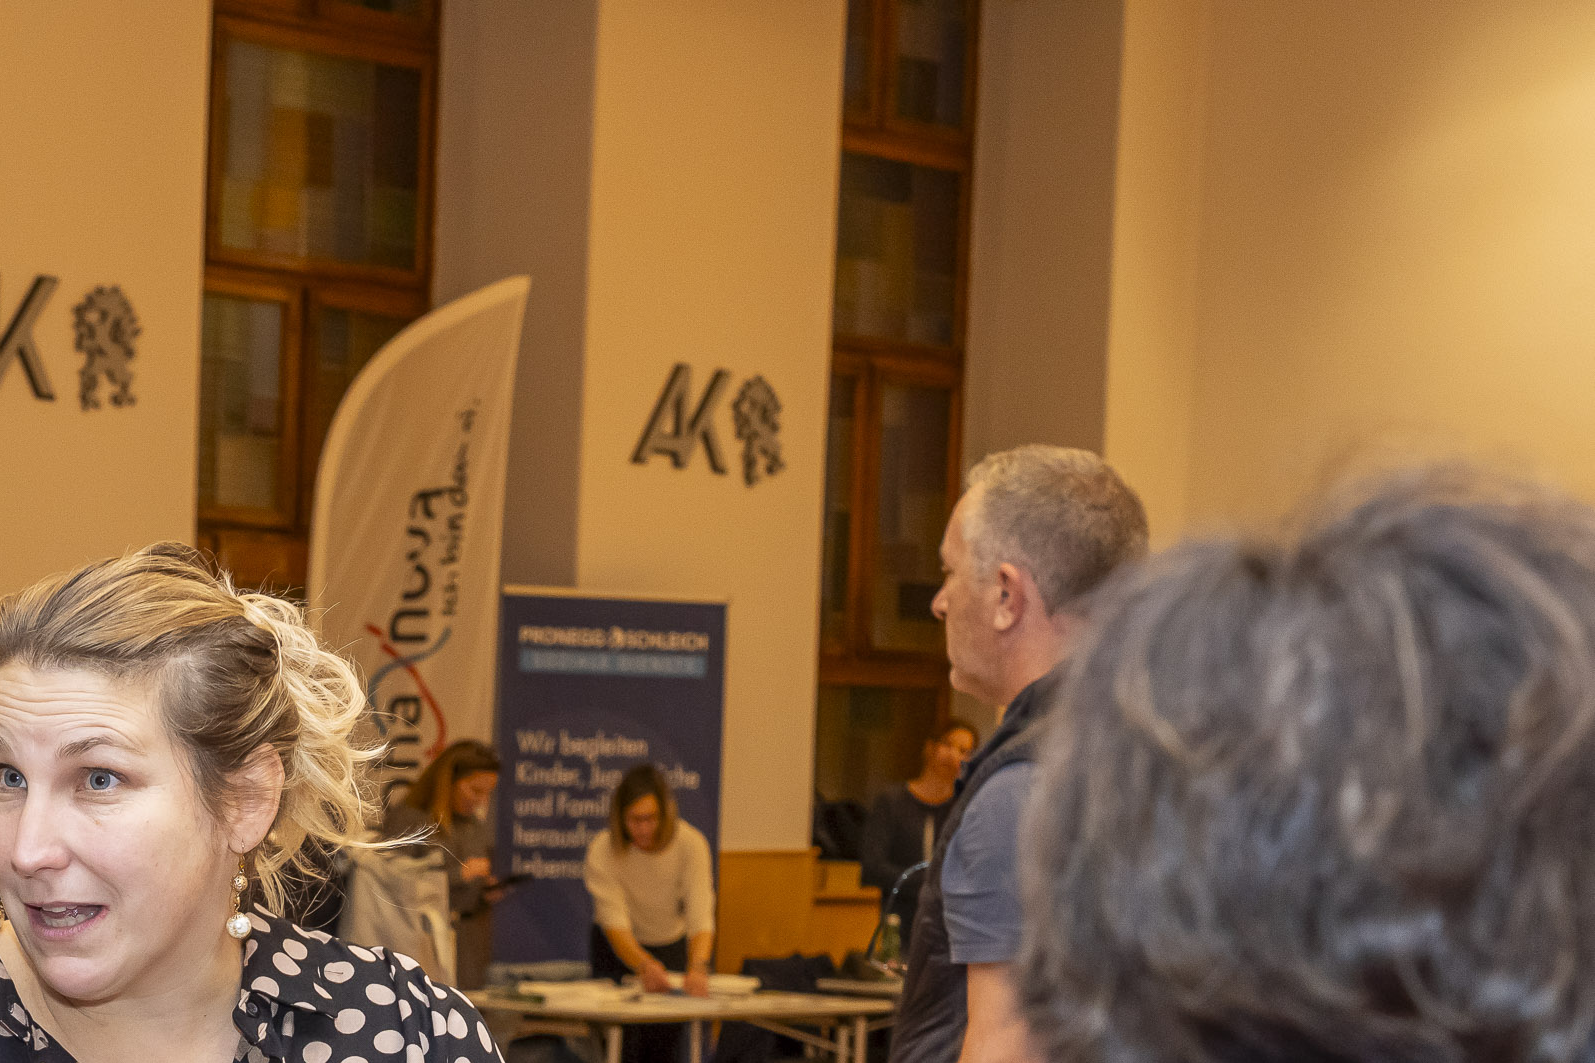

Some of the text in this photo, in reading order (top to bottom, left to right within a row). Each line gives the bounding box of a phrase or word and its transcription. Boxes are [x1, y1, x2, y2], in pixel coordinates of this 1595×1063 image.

[630, 363, 731, 475] AK
[516, 728, 649, 762] Wir begleiten
[513, 789, 554, 817] und
